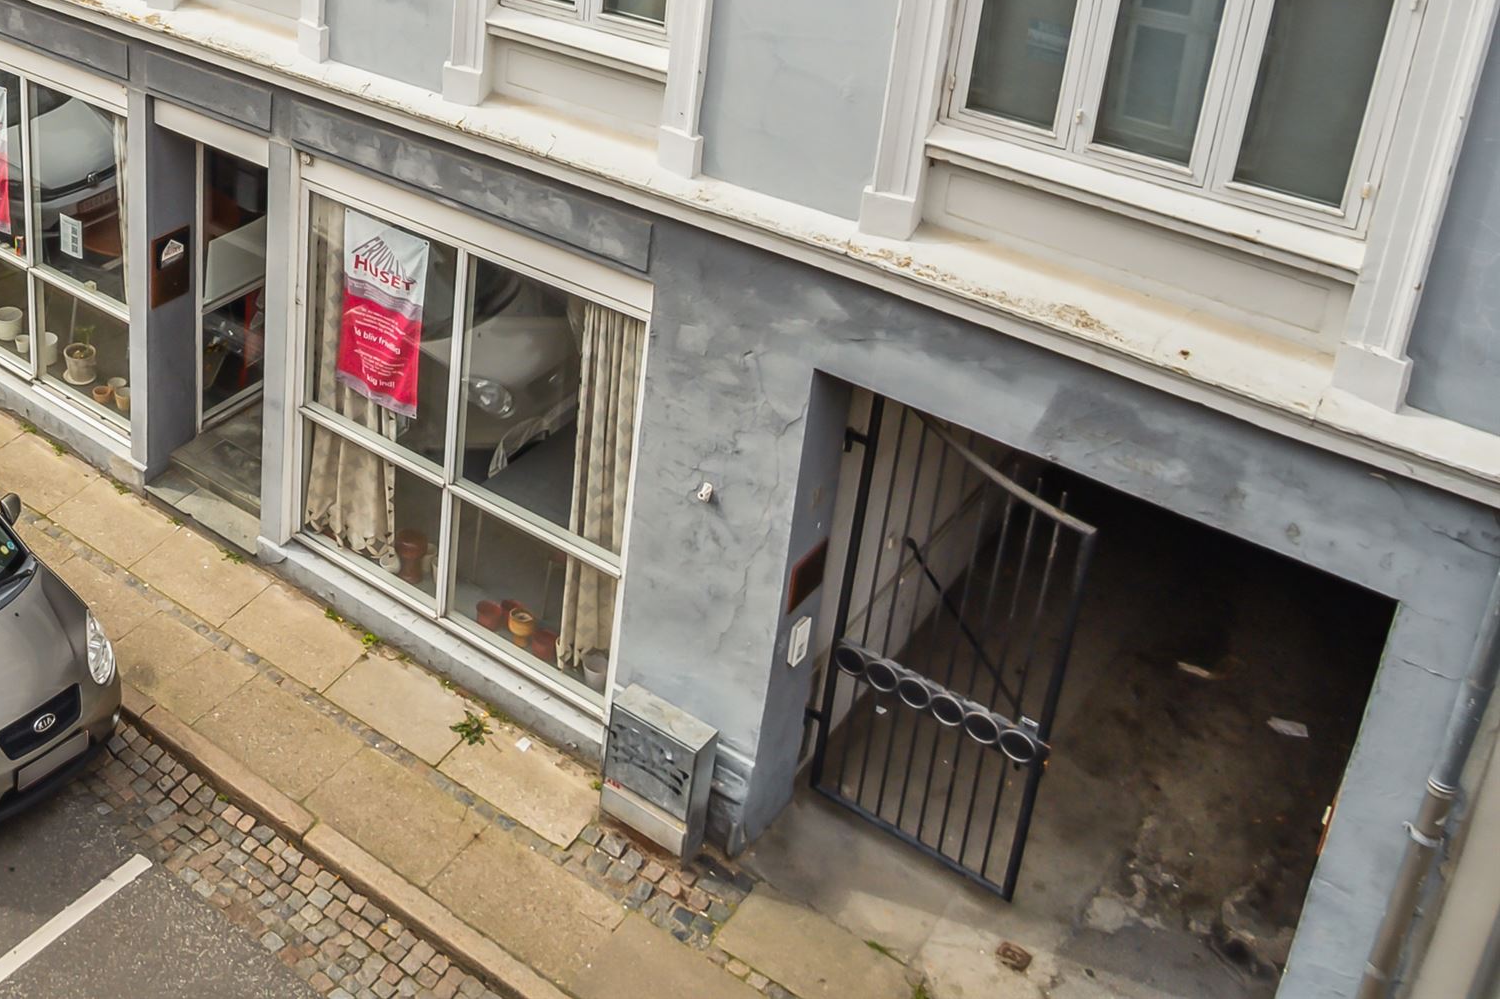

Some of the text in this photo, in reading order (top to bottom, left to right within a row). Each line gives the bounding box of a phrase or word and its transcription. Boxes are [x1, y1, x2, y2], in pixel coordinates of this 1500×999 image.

[354, 254, 414, 291] HUSET
[363, 330, 377, 342] bliv
[366, 373, 378, 386] kig
[38, 717, 52, 730] KIA
